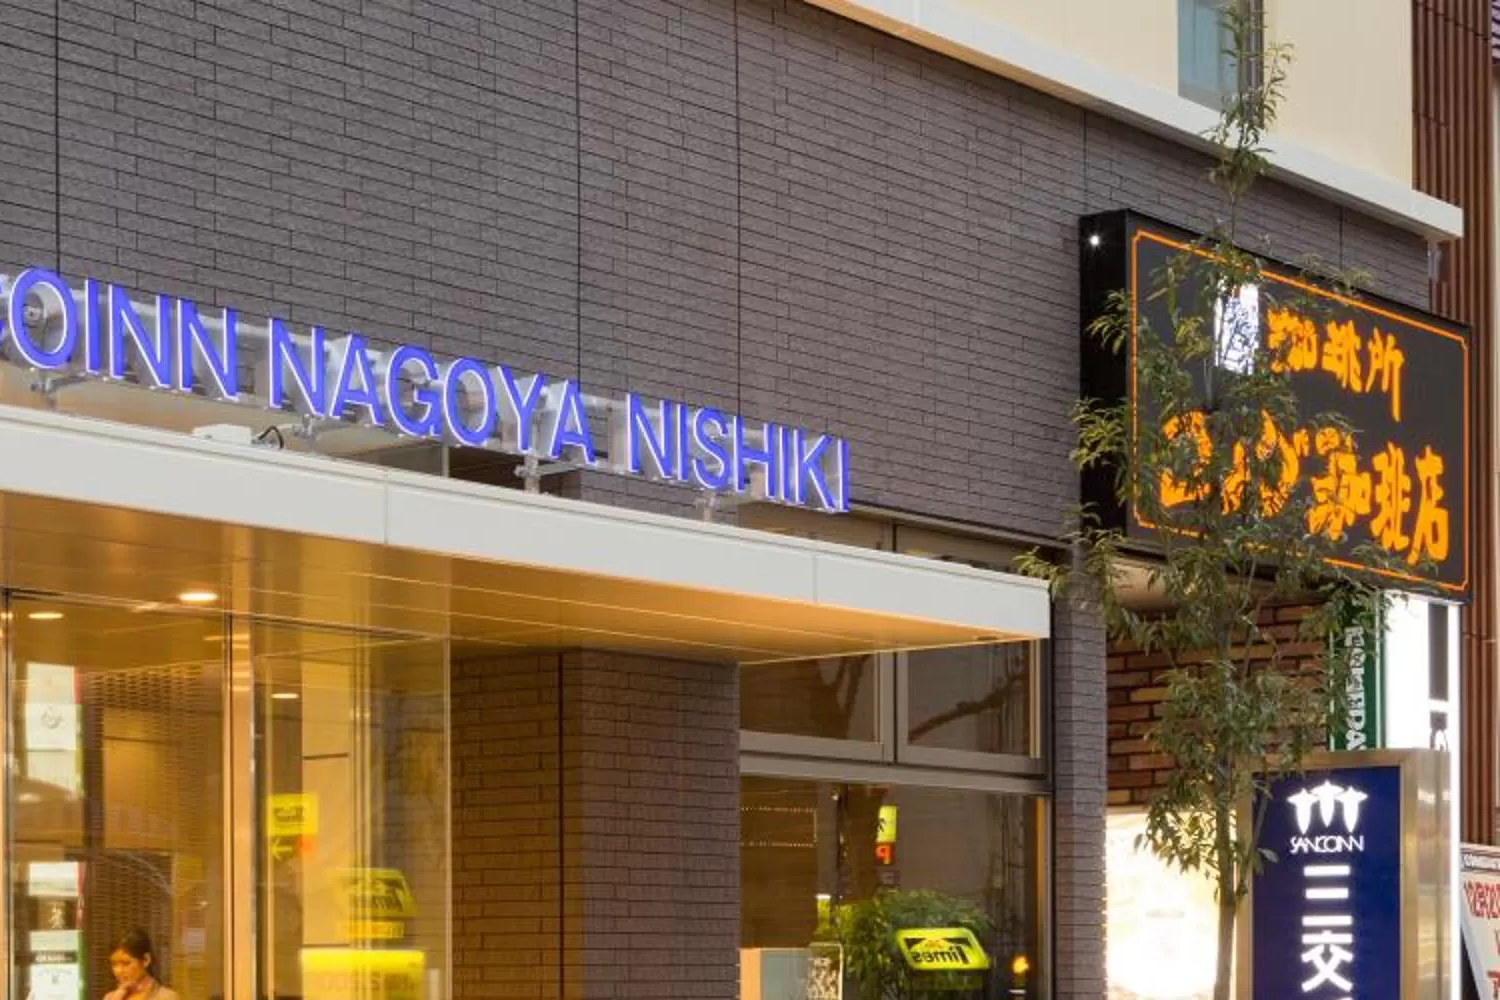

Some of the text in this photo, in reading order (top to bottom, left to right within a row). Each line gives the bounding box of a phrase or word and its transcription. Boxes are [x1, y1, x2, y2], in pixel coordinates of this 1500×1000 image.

[267, 316, 598, 466] NAGOYA
[625, 392, 850, 513] NISHIKI
[1289, 834, 1365, 855] SANCOINN
